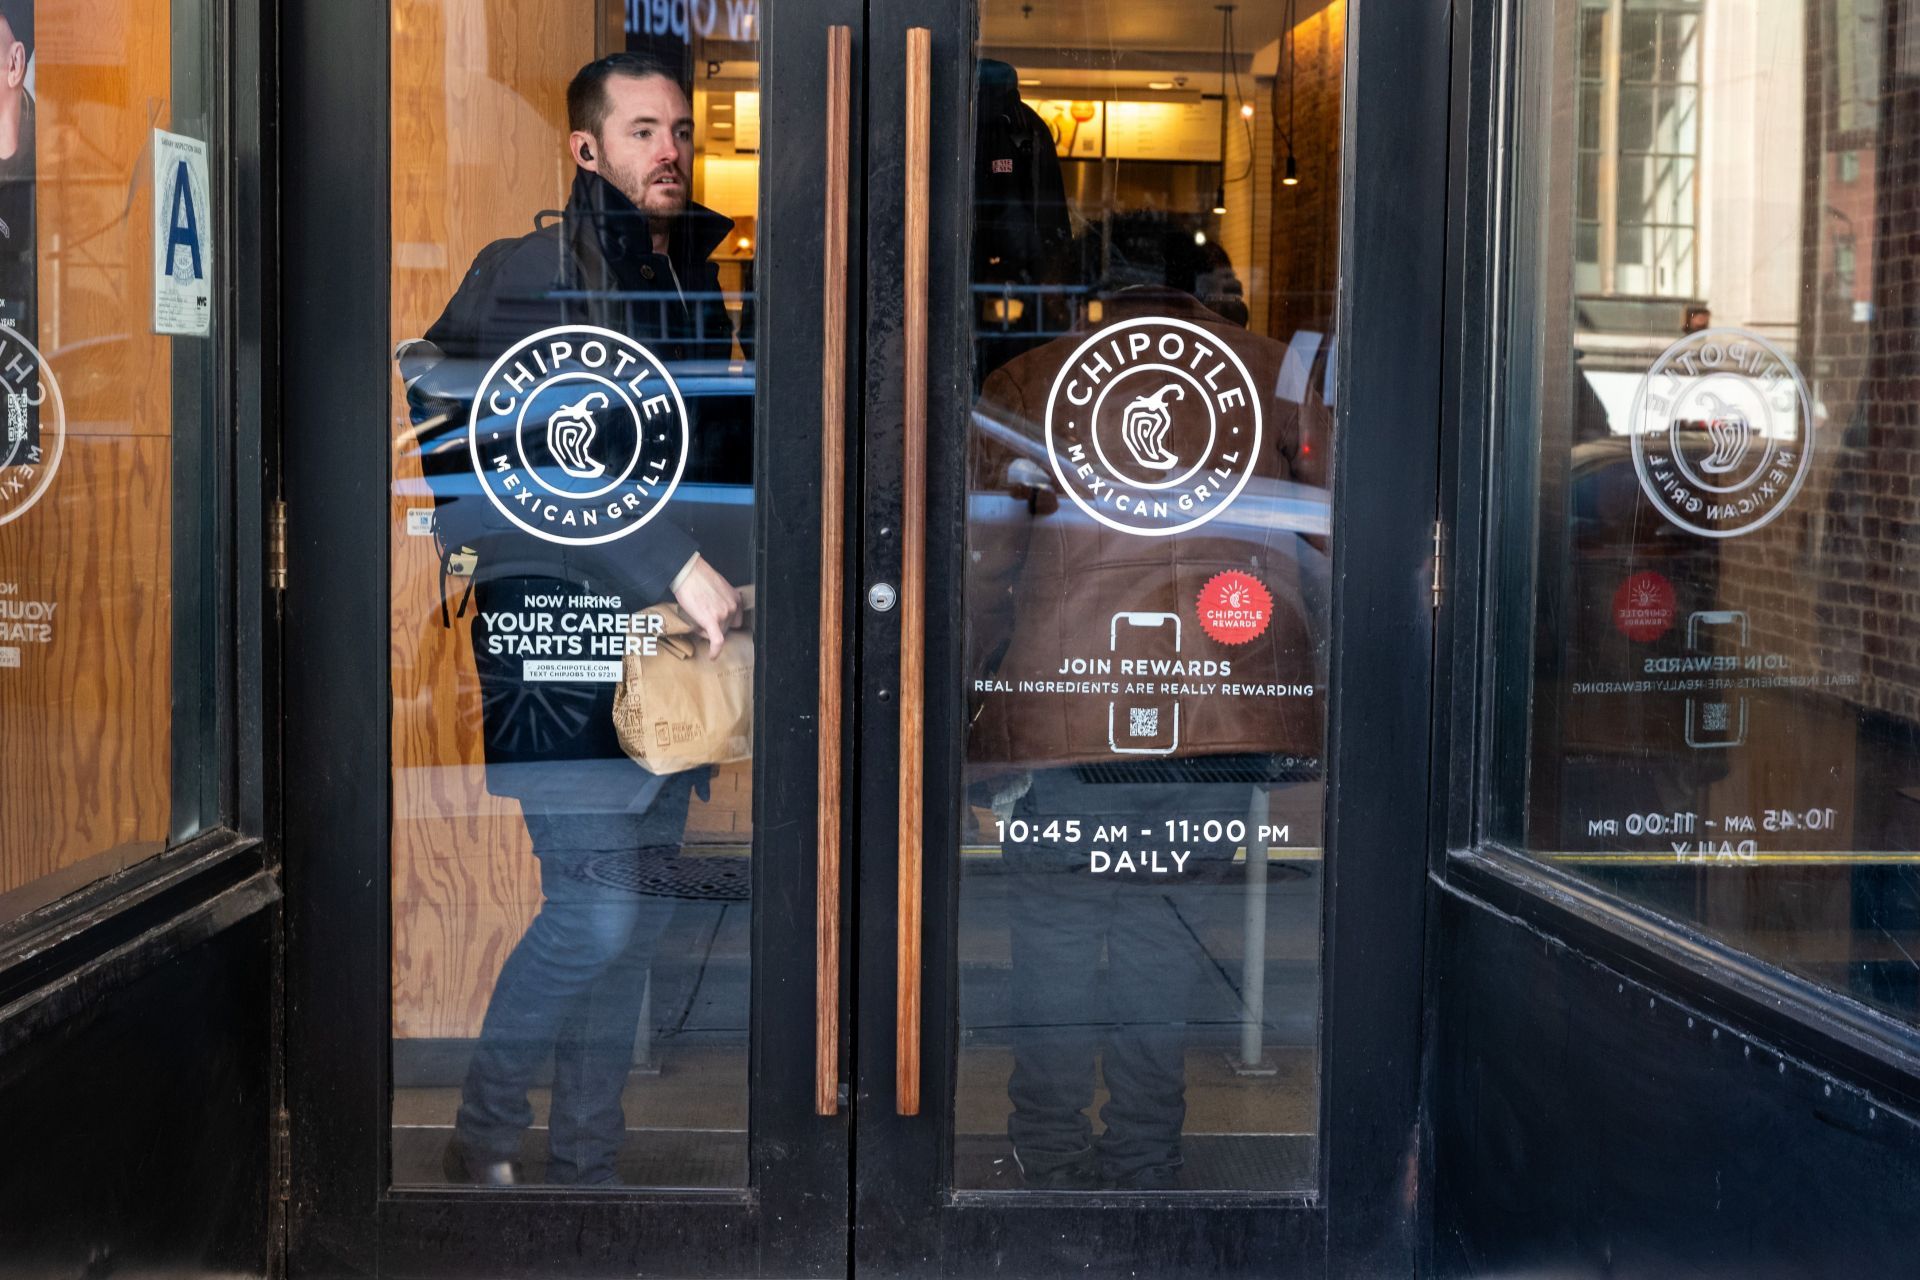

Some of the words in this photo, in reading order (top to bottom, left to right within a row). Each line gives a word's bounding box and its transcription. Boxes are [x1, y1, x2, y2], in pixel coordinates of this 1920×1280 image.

[165, 160, 204, 279] A
[490, 341, 672, 420] CHIPOTLE
[1067, 333, 1246, 414] CHIPOTLE
[493, 455, 598, 526] MEXICAN
[607, 458, 667, 519] GRILL
[1068, 444, 1167, 518] MEXICAN
[1179, 450, 1239, 510] GRILL
[524, 594, 564, 608] NOW
[568, 595, 622, 609] HIRING
[481, 612, 554, 633] YOUR
[560, 612, 665, 634] CAREER
[1207, 609, 1263, 620] CHIPOTLE
[1212, 620, 1257, 629] REWARDS
[488, 635, 583, 656] STARTS
[590, 636, 657, 656] HERE
[1059, 658, 1111, 675] JOIN
[1121, 659, 1231, 677] REWARDS
[974, 680, 1013, 692] REAL
[1019, 681, 1119, 694] INGREDIENTS
[1125, 682, 1154, 694] ARE
[1160, 683, 1217, 695] REALLY
[1221, 684, 1314, 697] REWARDING
[995, 820, 1081, 843] 10:45
[1093, 825, 1127, 842] AM
[1165, 820, 1246, 843] 11:00
[1258, 825, 1289, 842] PM
